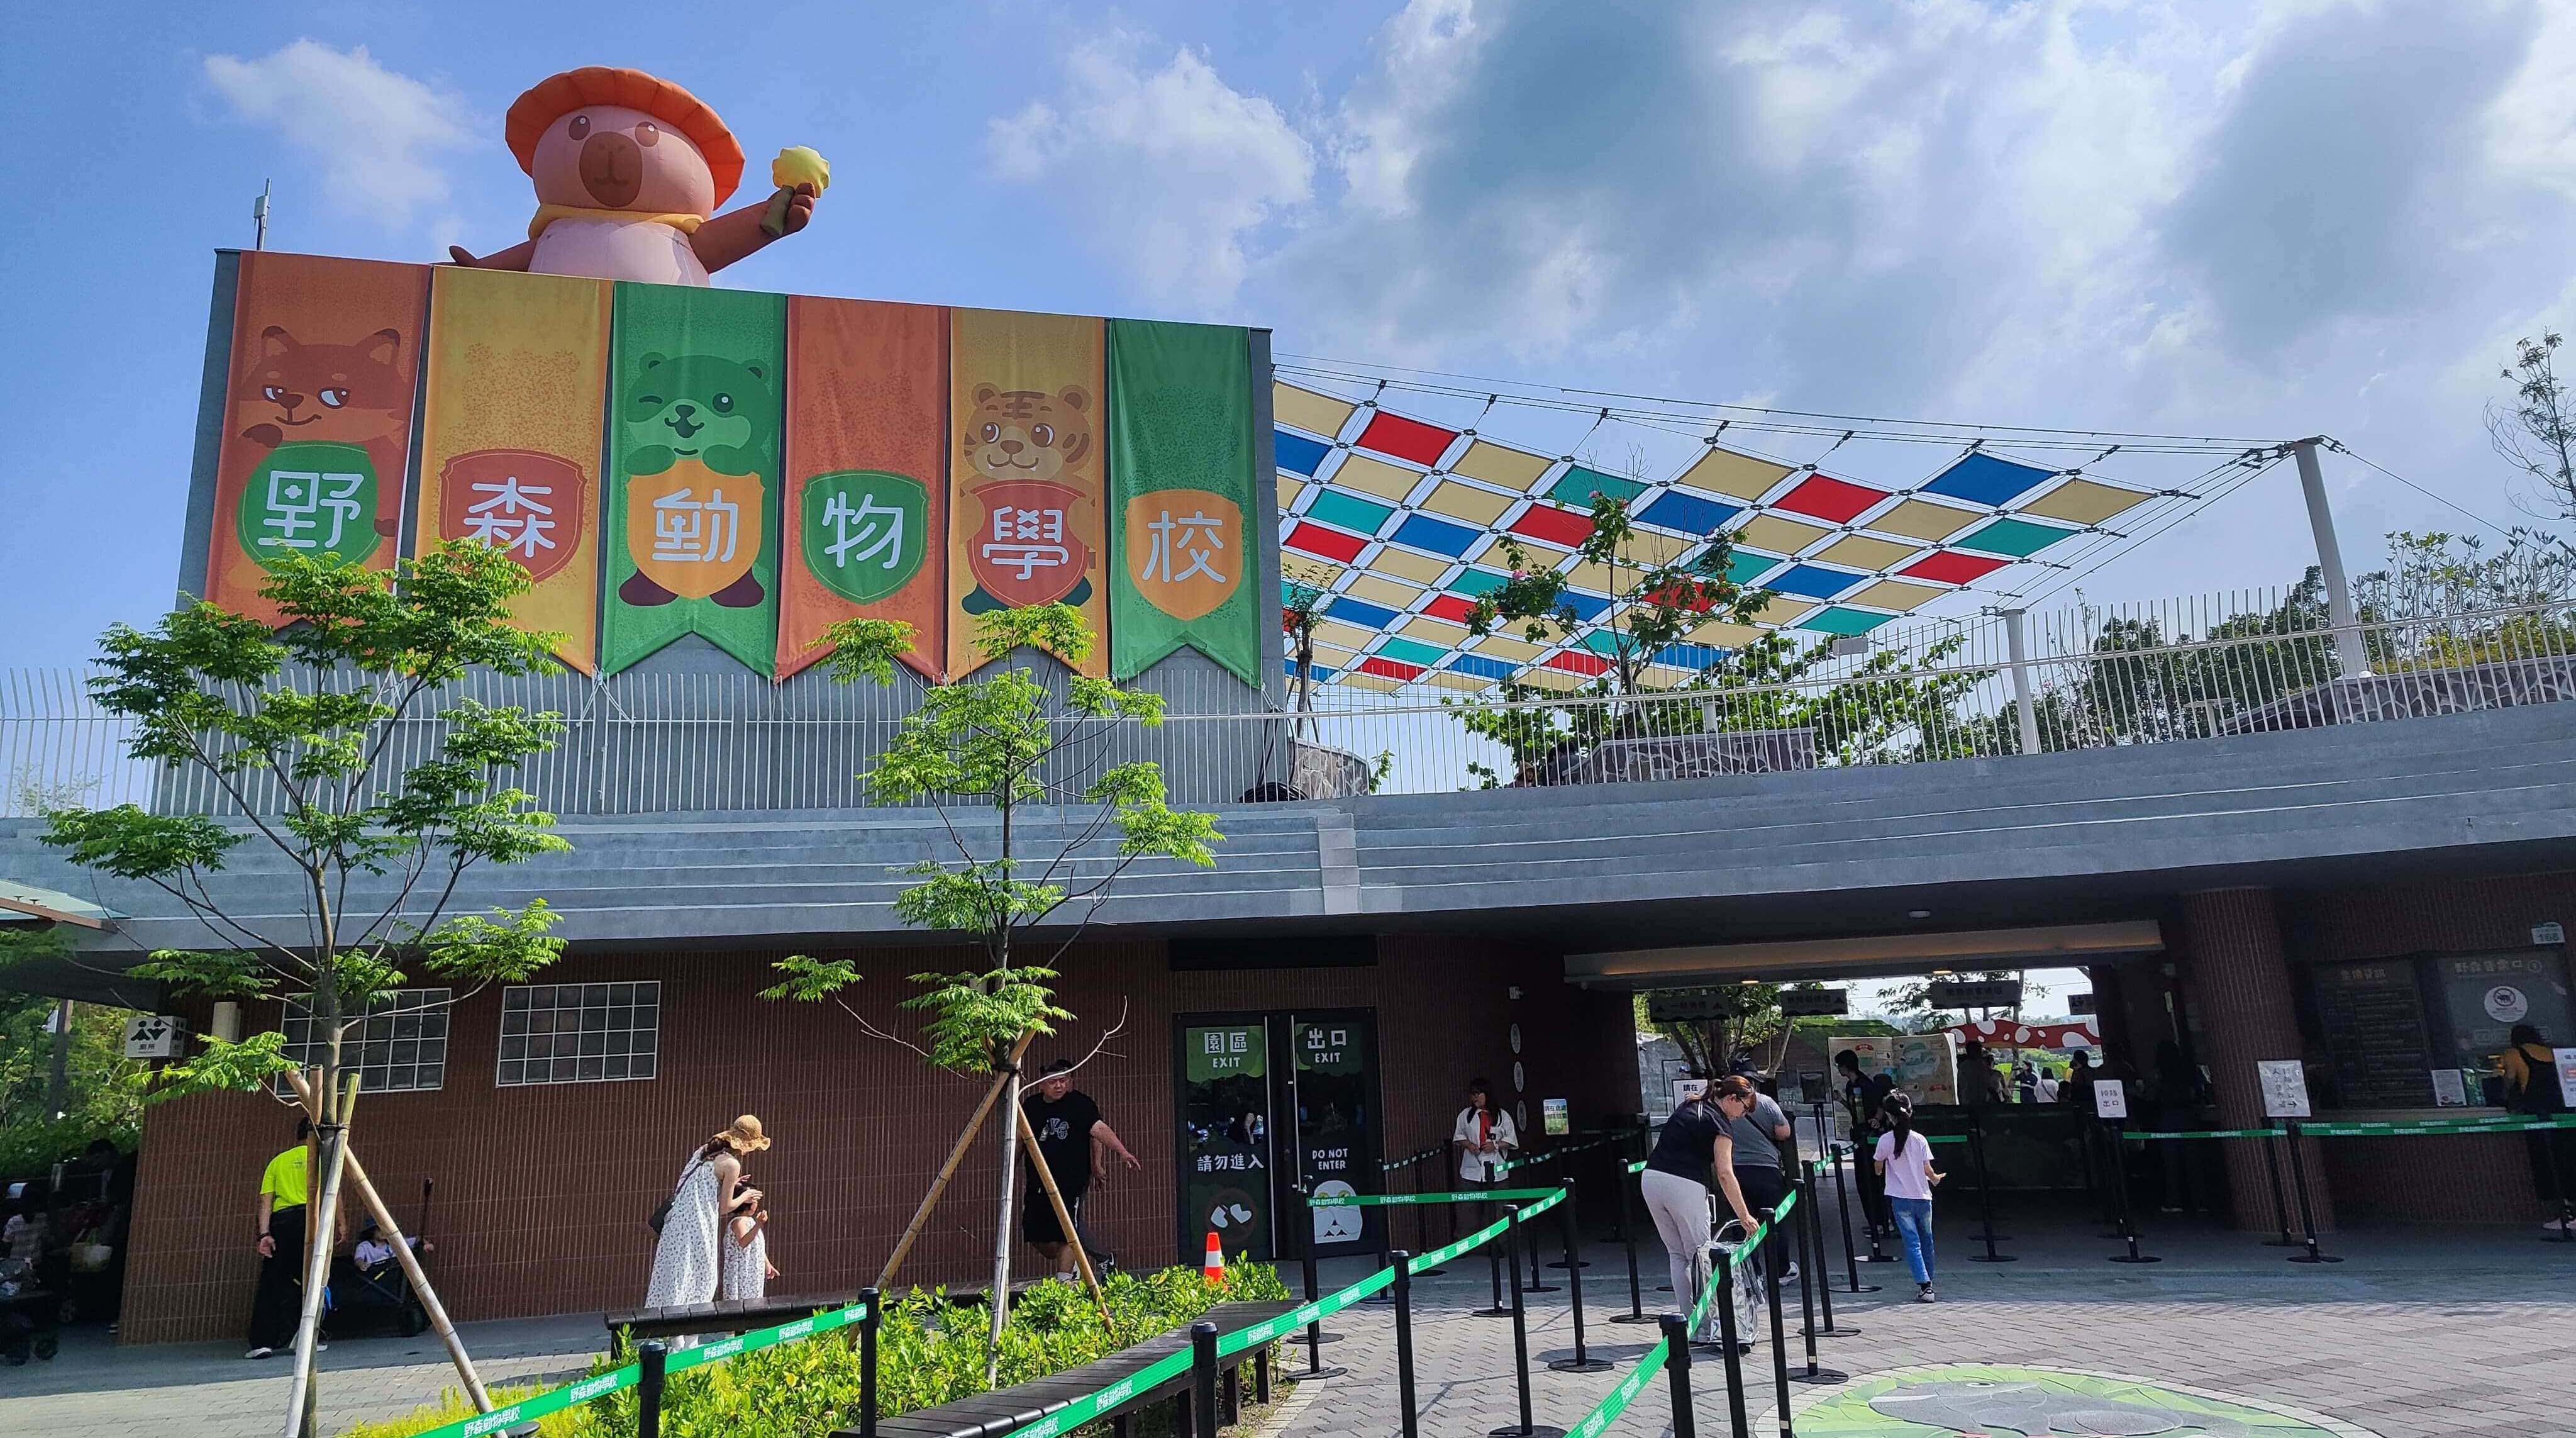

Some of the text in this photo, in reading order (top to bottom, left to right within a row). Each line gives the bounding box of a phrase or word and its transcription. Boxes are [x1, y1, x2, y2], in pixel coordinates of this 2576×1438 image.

[257, 469, 1227, 584] 野 森 動 物 學 校
[1204, 1032, 1248, 1054] 園區
[1307, 1028, 1347, 1049] 出口
[1212, 1057, 1241, 1068] EXIT
[1314, 1052, 1341, 1064] EXIT
[1197, 1153, 1264, 1173] 請勿進入
[1312, 1148, 1348, 1160] DO NOT
[1318, 1159, 1346, 1170] ENTER
[702, 1338, 745, 1361] 野森動物學校
[569, 1373, 618, 1403] 野森動物學校
[463, 1405, 521, 1438] 野森動物學校
